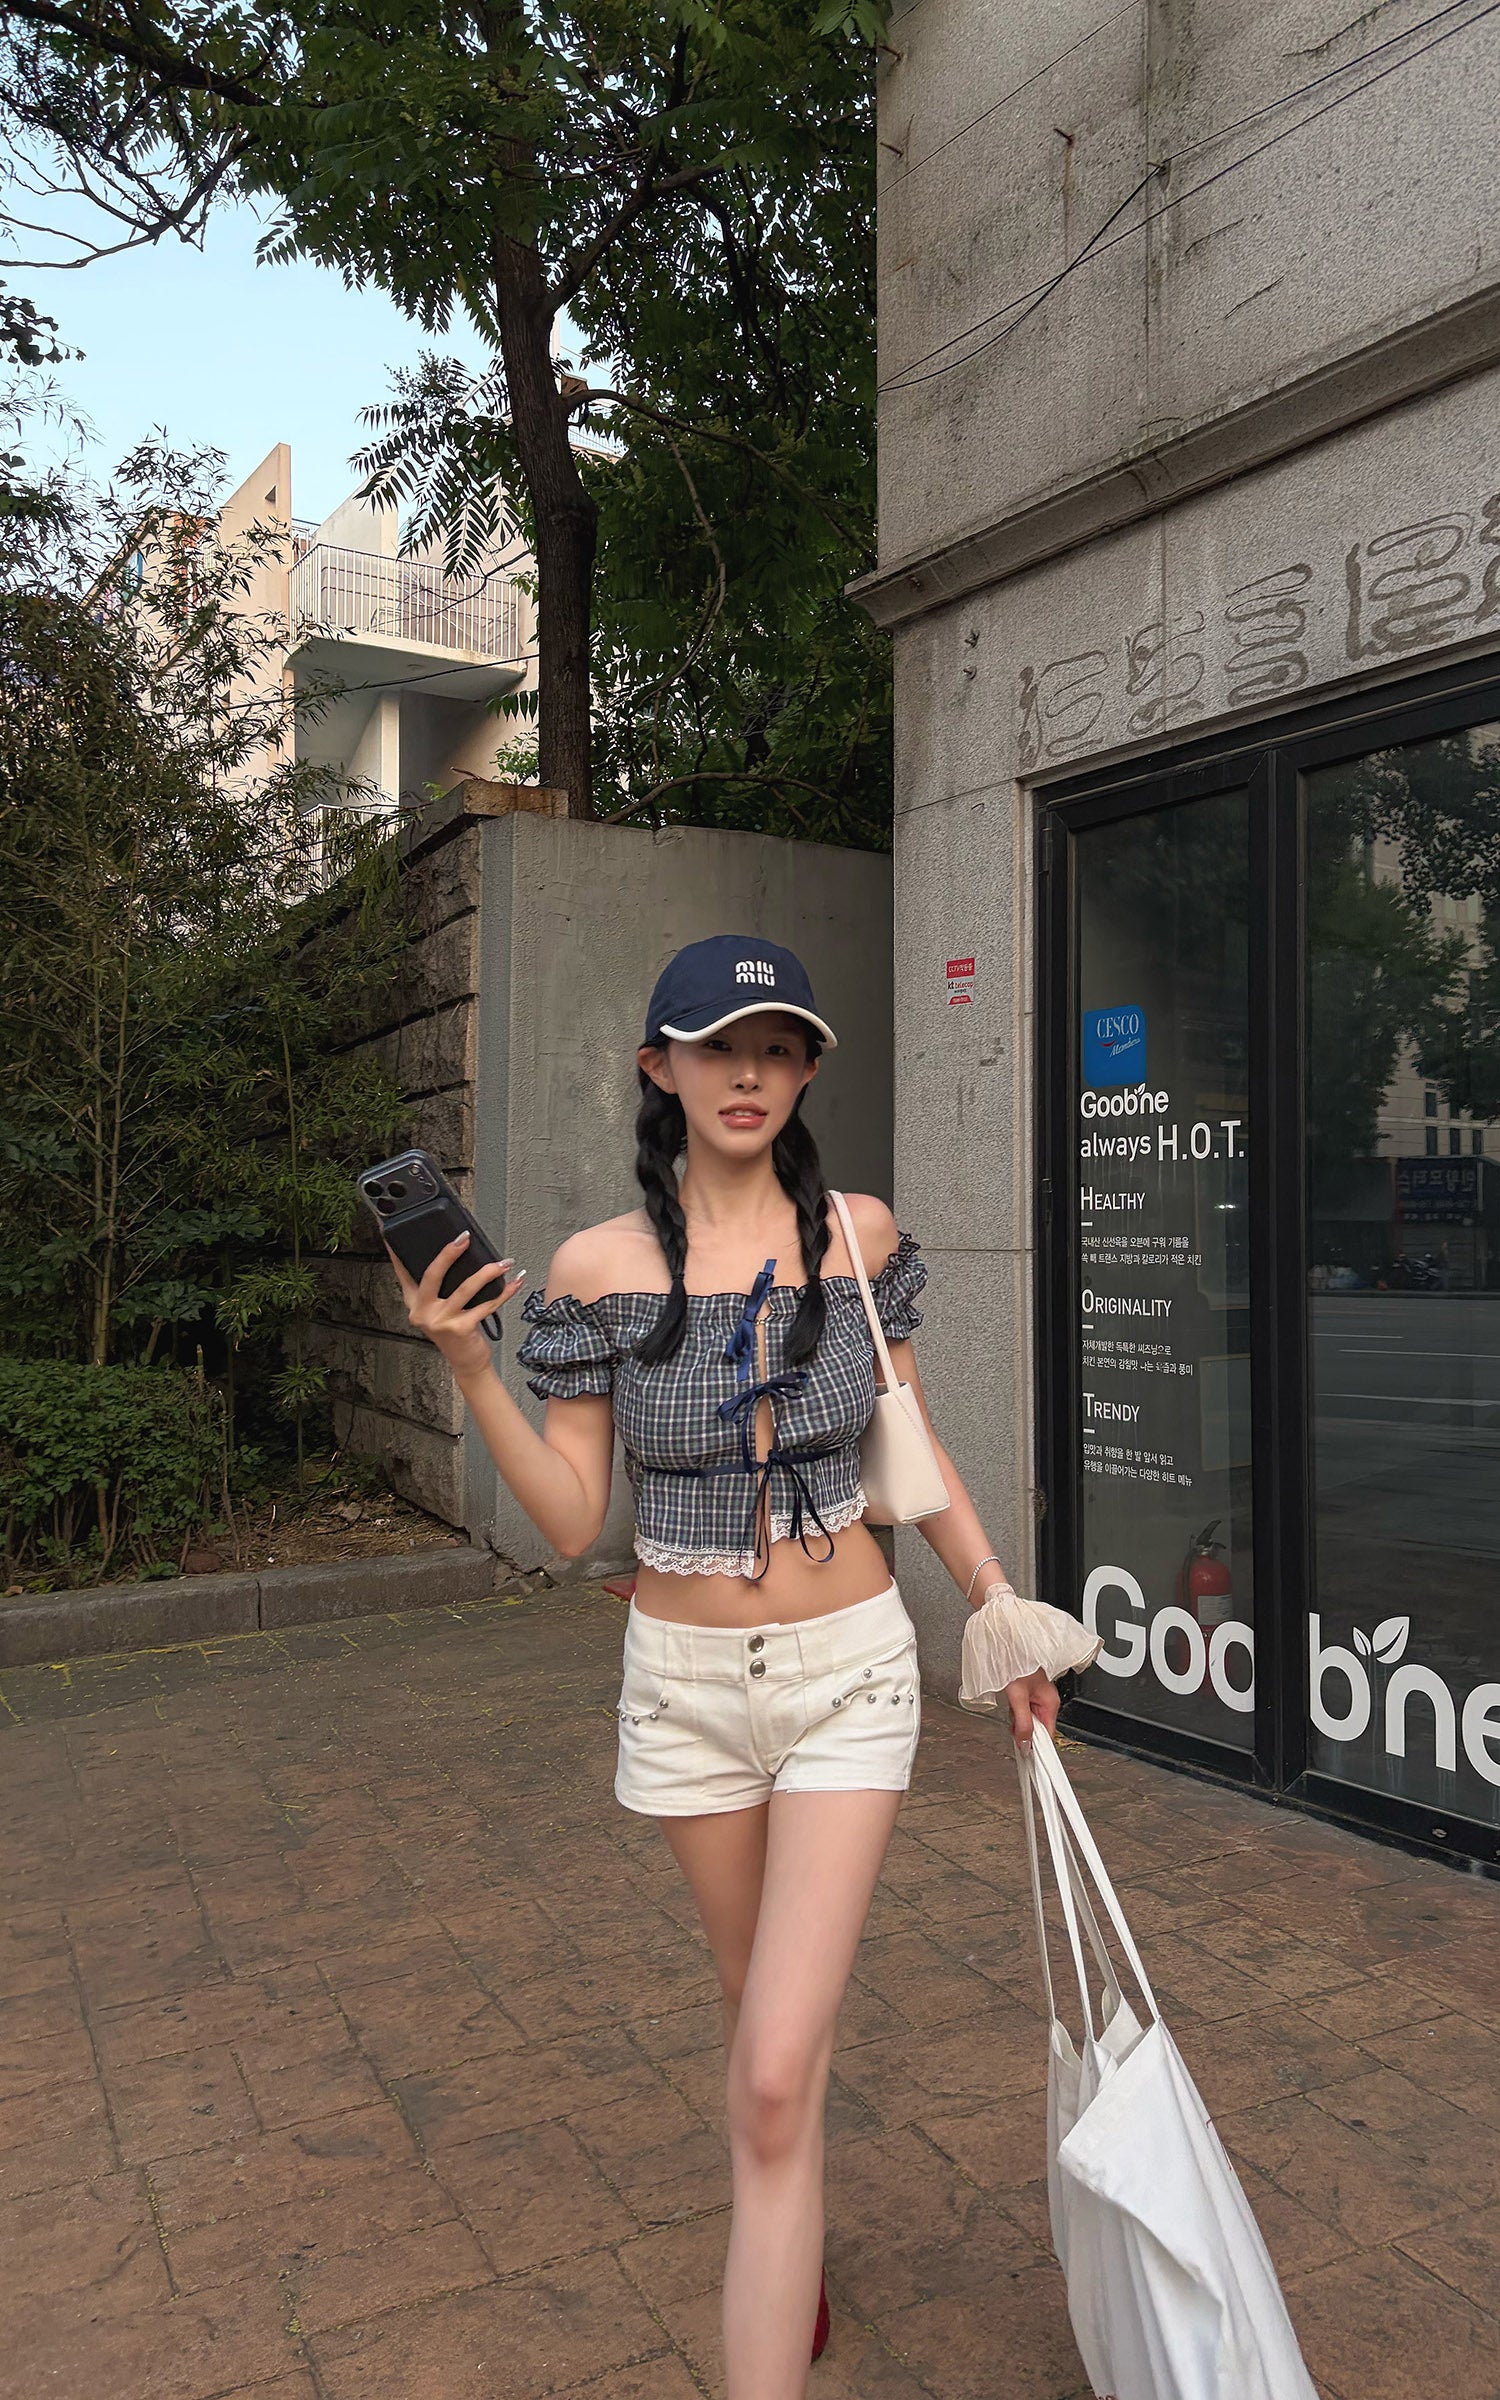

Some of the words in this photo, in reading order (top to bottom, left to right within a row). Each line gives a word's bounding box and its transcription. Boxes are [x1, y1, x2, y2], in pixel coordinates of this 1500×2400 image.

[948, 981, 954, 989] kt
[1097, 1013, 1139, 1038] CESCO
[1080, 1132, 1151, 1162] always
[1158, 1120, 1244, 1161] H.O.T.
[1081, 1237, 1100, 1247] 국내산
[1130, 1237, 1150, 1248] 오븐에
[1152, 1237, 1166, 1248] 구워
[1168, 1237, 1189, 1248] 기름을
[1098, 1254, 1118, 1264] 트랜스
[1120, 1254, 1140, 1264] 지방과
[1142, 1254, 1169, 1264] 칼로리가
[1170, 1254, 1185, 1265] 적은
[1187, 1254, 1202, 1266] 치킨
[1082, 1340, 1114, 1352] 자체개발한
[1116, 1342, 1135, 1353] 독특한
[1138, 1344, 1171, 1355] 씨즈닝으로
[1082, 1356, 1096, 1367] 치킨
[1097, 1357, 1117, 1368] 본연의
[1179, 1363, 1193, 1375] 풍미
[1083, 1443, 1102, 1456] 입맛과
[1105, 1445, 1123, 1459] 취향을
[1126, 1449, 1132, 1460] 한
[1135, 1451, 1141, 1462] 발
[1143, 1452, 1157, 1464] 앞서
[1160, 1454, 1174, 1466] 읽고
[1084, 1460, 1103, 1473] 유행을
[1105, 1463, 1137, 1478] 이끌어가는
[1139, 1469, 1160, 1482] 다양한
[1162, 1472, 1176, 1483] 히트
[1178, 1474, 1192, 1486] 메뉴
